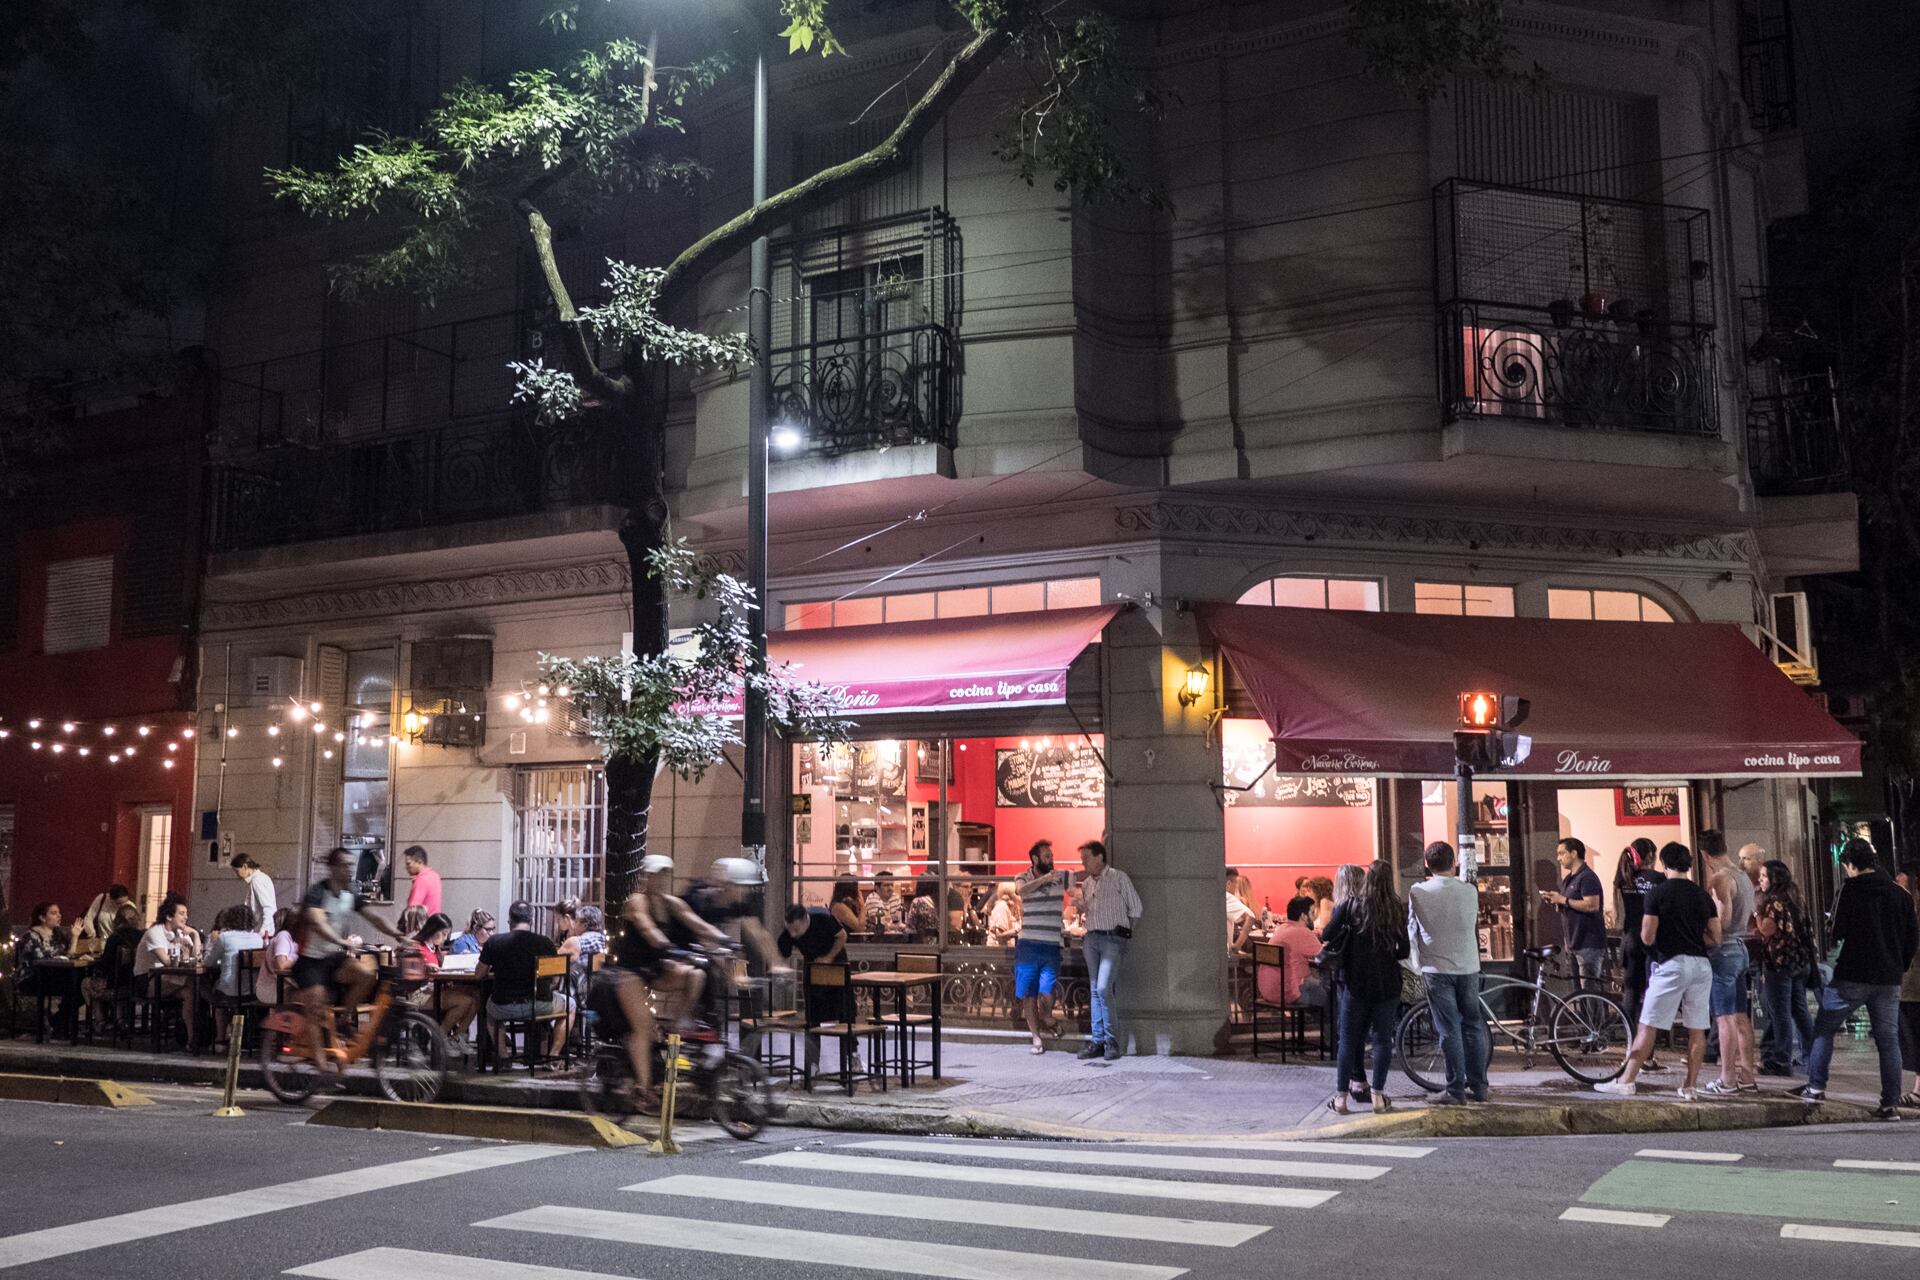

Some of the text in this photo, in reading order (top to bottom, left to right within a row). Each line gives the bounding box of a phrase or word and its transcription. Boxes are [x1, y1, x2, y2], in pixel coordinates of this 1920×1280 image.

[828, 685, 881, 708] Doña
[949, 680, 1059, 700] cocina tipo casa
[1554, 749, 1612, 773] Doña
[1744, 751, 1841, 770] cocina tipo casa
